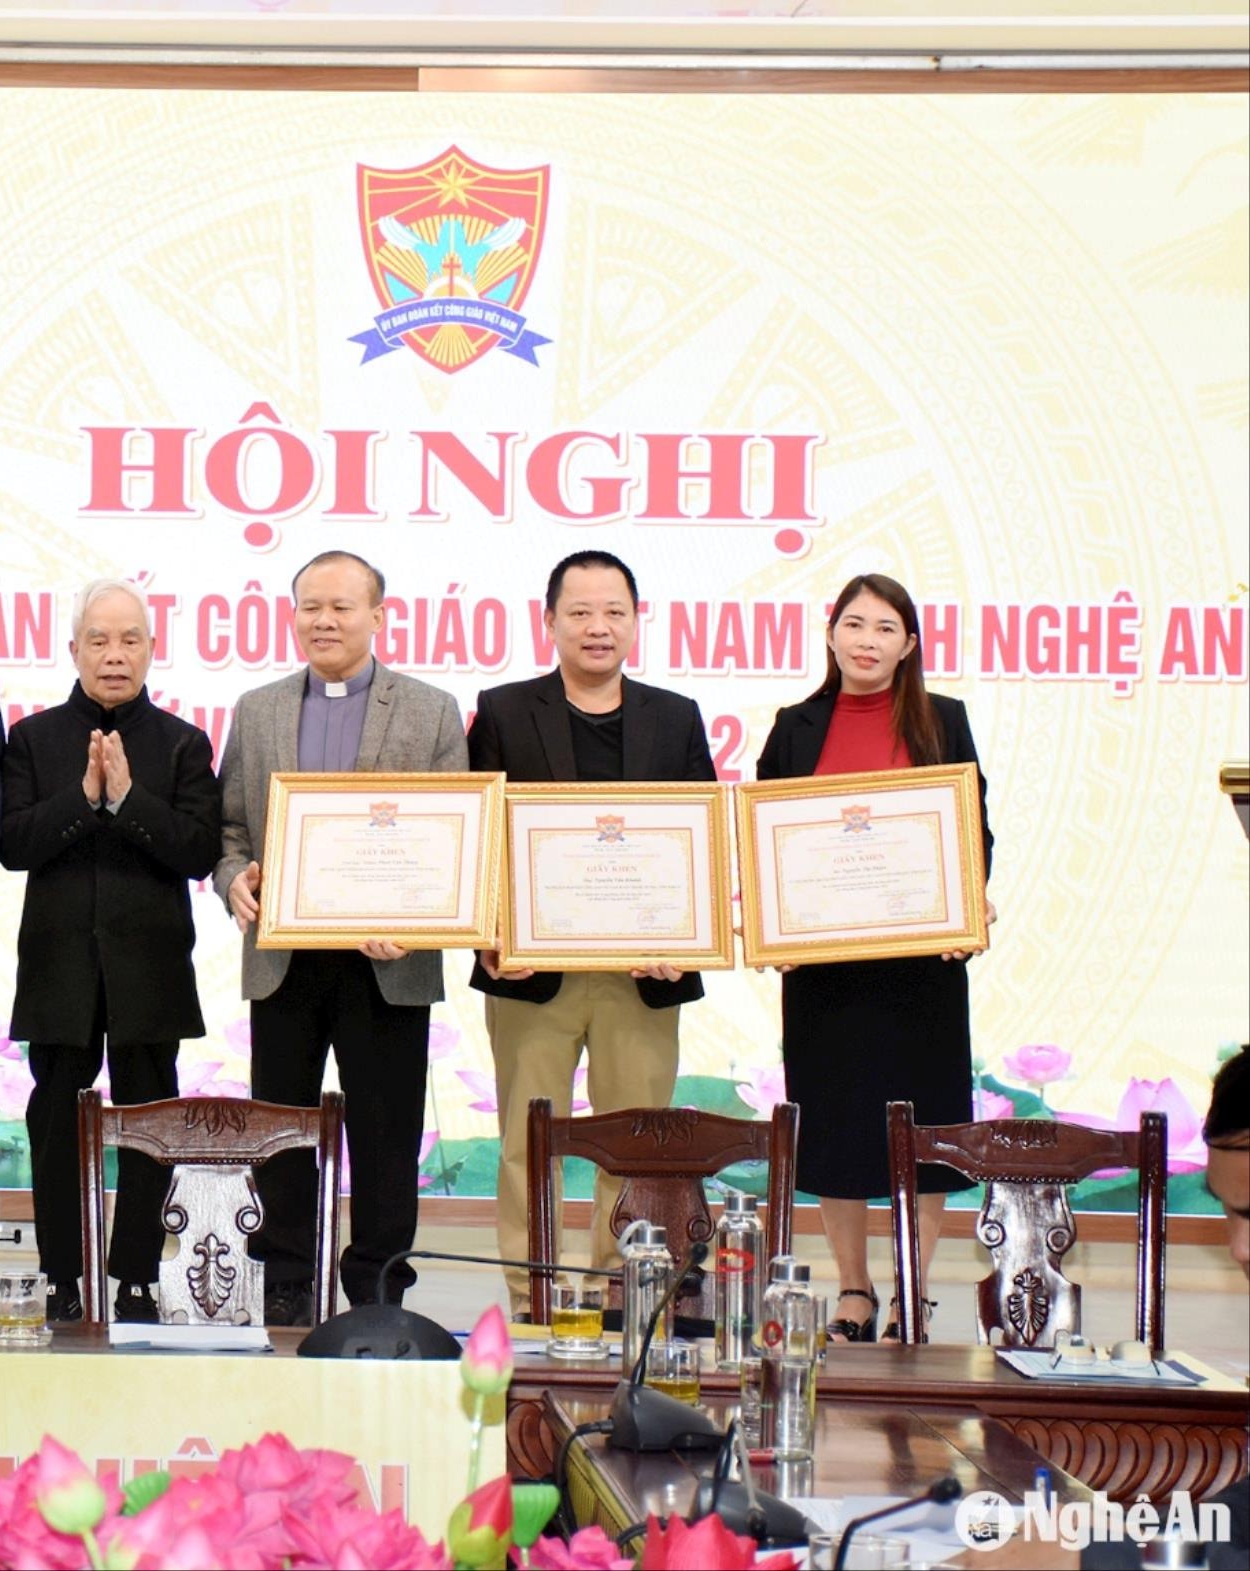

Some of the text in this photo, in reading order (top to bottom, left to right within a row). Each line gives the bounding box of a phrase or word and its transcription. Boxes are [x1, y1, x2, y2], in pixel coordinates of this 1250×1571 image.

[78, 401, 820, 554] HỘI NGHỊ
[375, 583, 507, 667] GIÁO
[669, 601, 803, 671] NAM
[980, 592, 1138, 690] NGHỆ
[1160, 608, 1244, 676] AN
